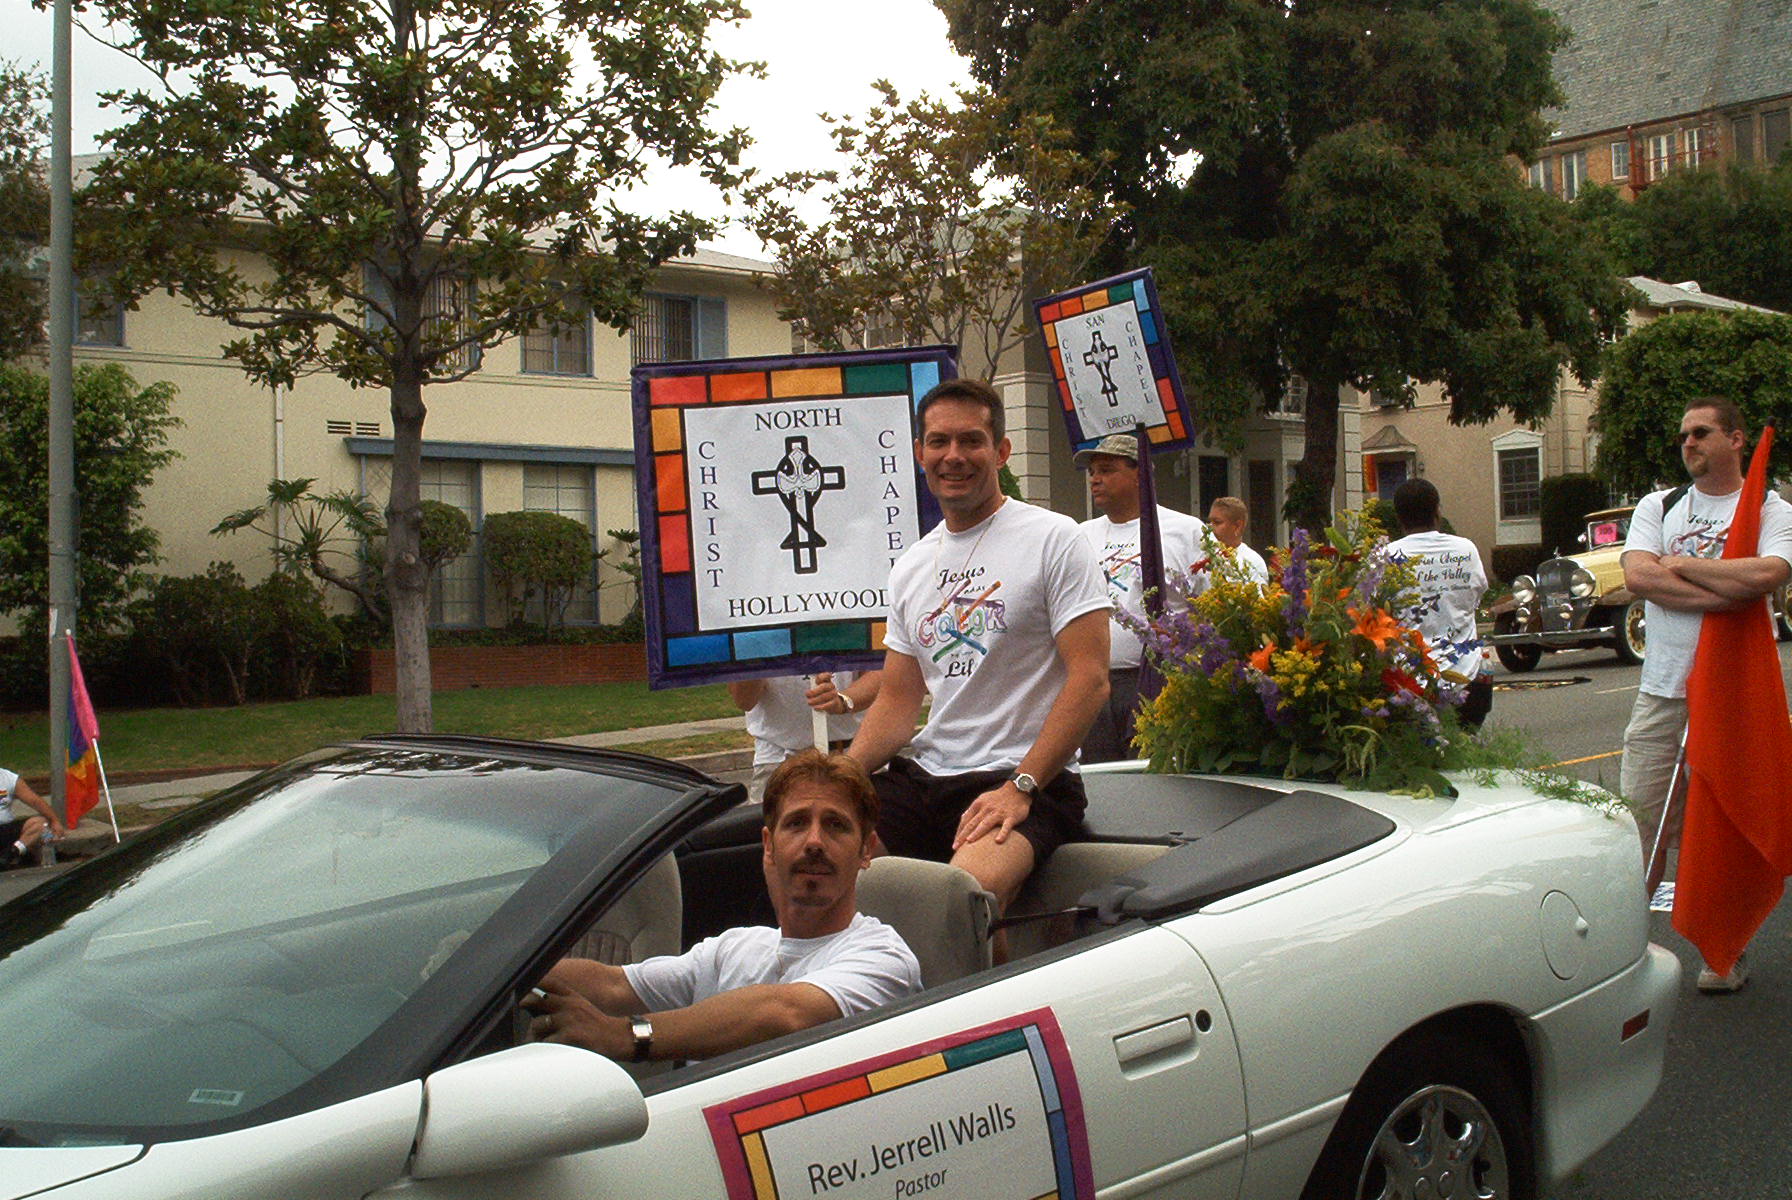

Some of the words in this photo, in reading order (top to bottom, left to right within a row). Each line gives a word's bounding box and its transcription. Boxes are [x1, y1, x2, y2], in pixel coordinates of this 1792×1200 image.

[1086, 314, 1105, 330] SAN
[1061, 338, 1087, 418] CHRIST
[1125, 320, 1154, 404] CHAPEL
[755, 407, 842, 431] NORTH
[1106, 414, 1137, 430] DIEGO
[698, 441, 724, 588] CHRIST
[937, 566, 985, 590] Jesus
[807, 1159, 866, 1194] Rev.
[870, 1121, 947, 1175] Jerrell
[949, 1103, 1016, 1146] Walls
[896, 1168, 947, 1200] Pastor
